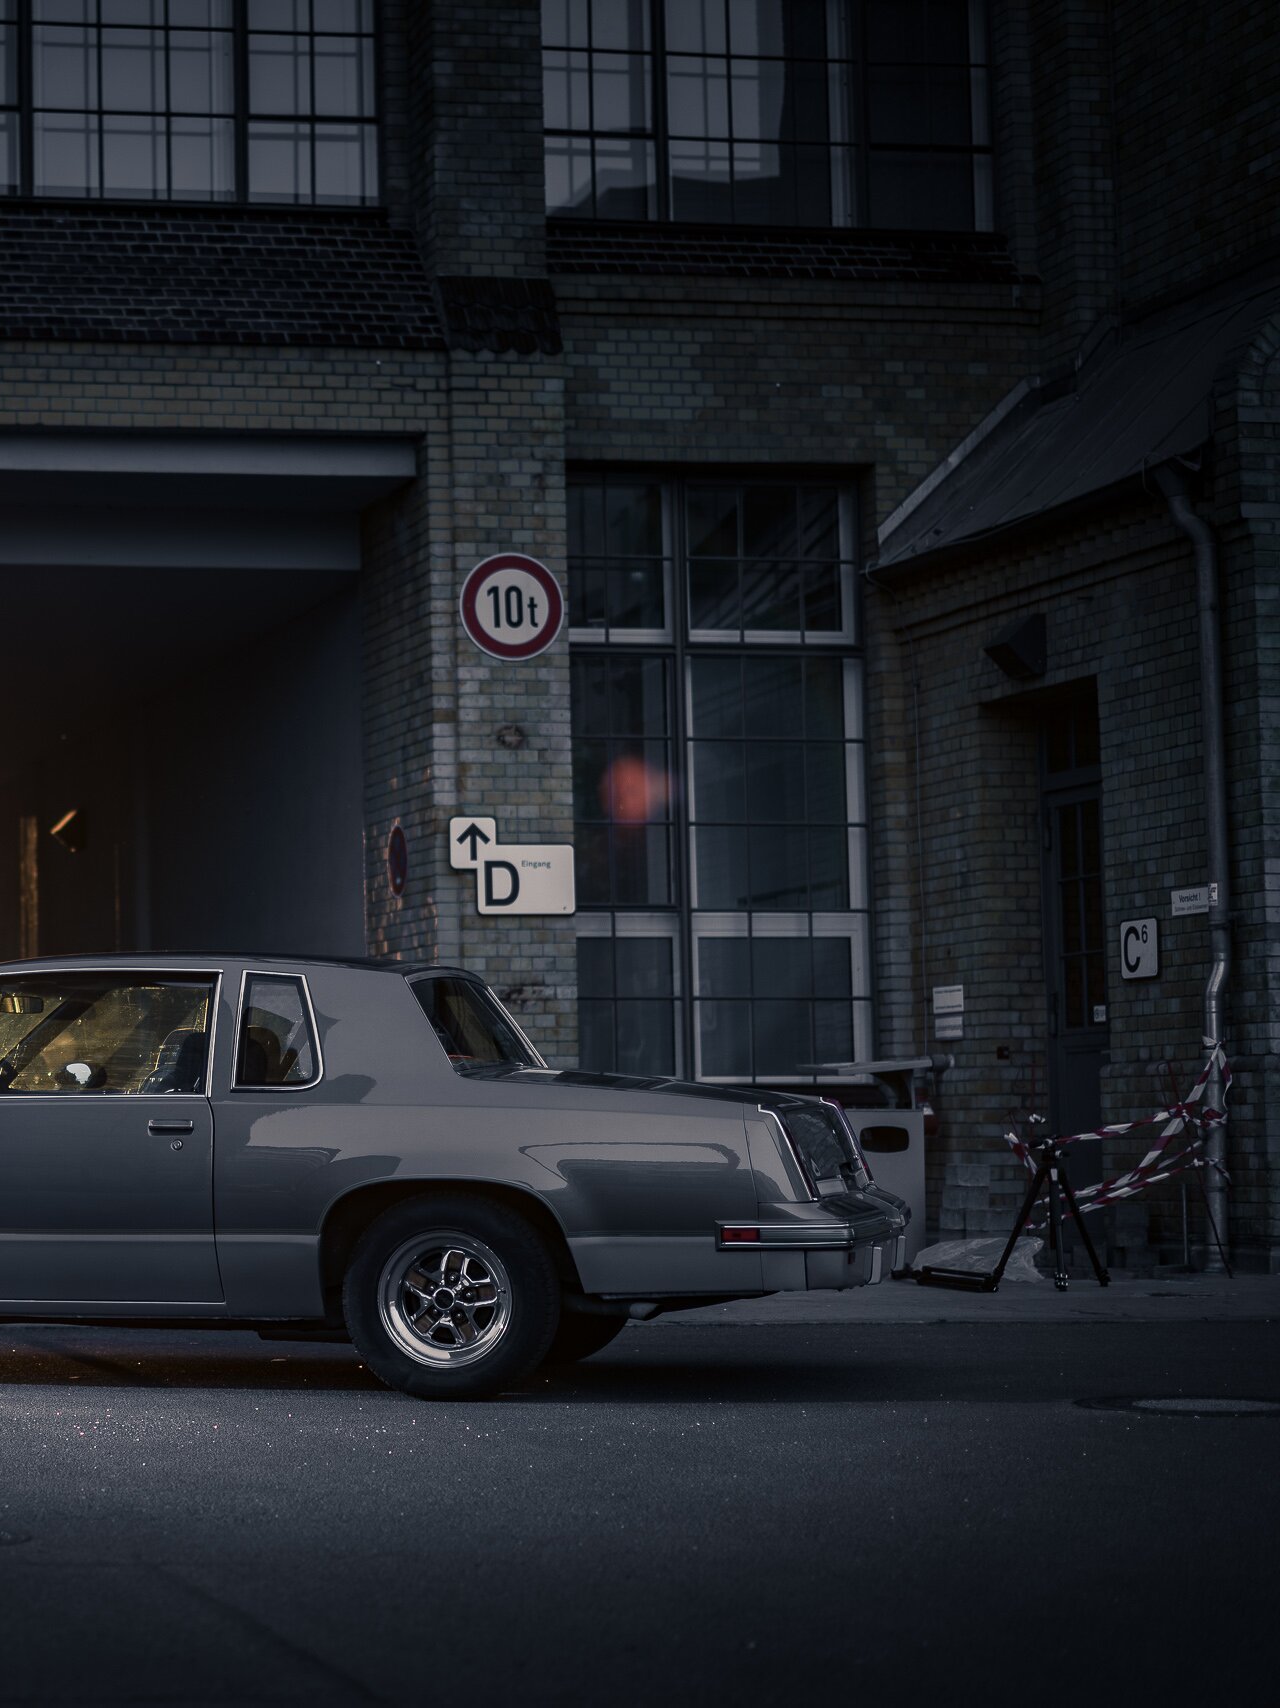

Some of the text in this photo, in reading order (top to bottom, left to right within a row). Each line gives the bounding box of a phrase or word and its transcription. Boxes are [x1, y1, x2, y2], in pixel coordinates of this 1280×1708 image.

[487, 585, 539, 629] 10t
[484, 860, 520, 907] D
[521, 860, 552, 870] Eingang
